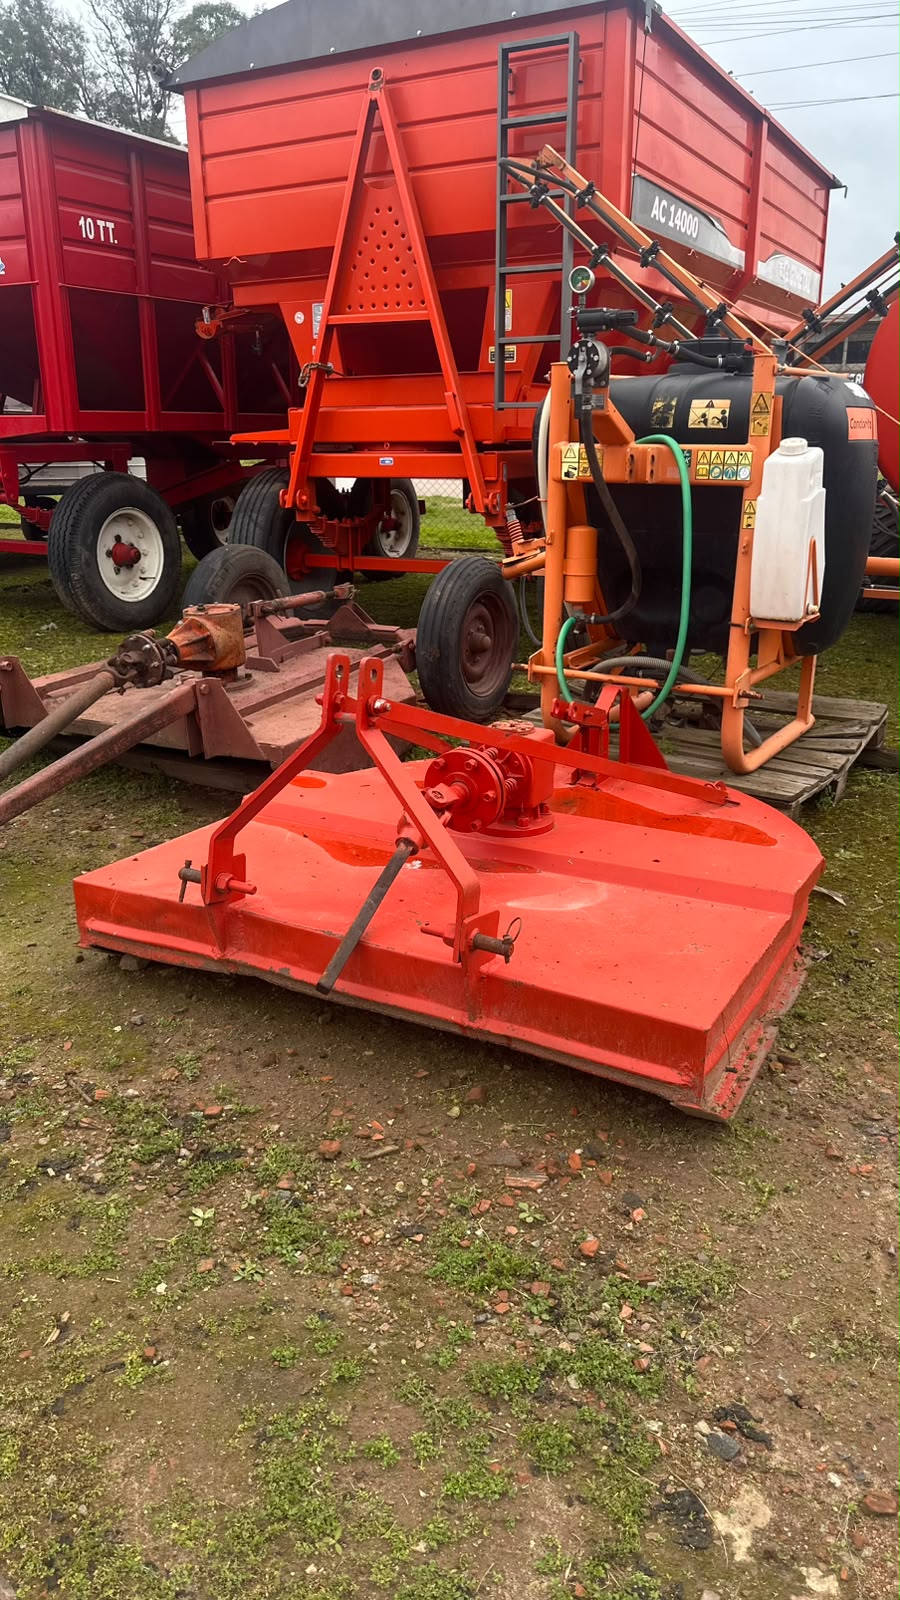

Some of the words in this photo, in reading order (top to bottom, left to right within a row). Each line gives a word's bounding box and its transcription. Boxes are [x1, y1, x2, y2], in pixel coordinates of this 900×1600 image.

[79, 216, 95, 239] 10
[97, 220, 118, 244] TT.
[651, 196, 667, 224] AC
[668, 204, 698, 238] 14000
